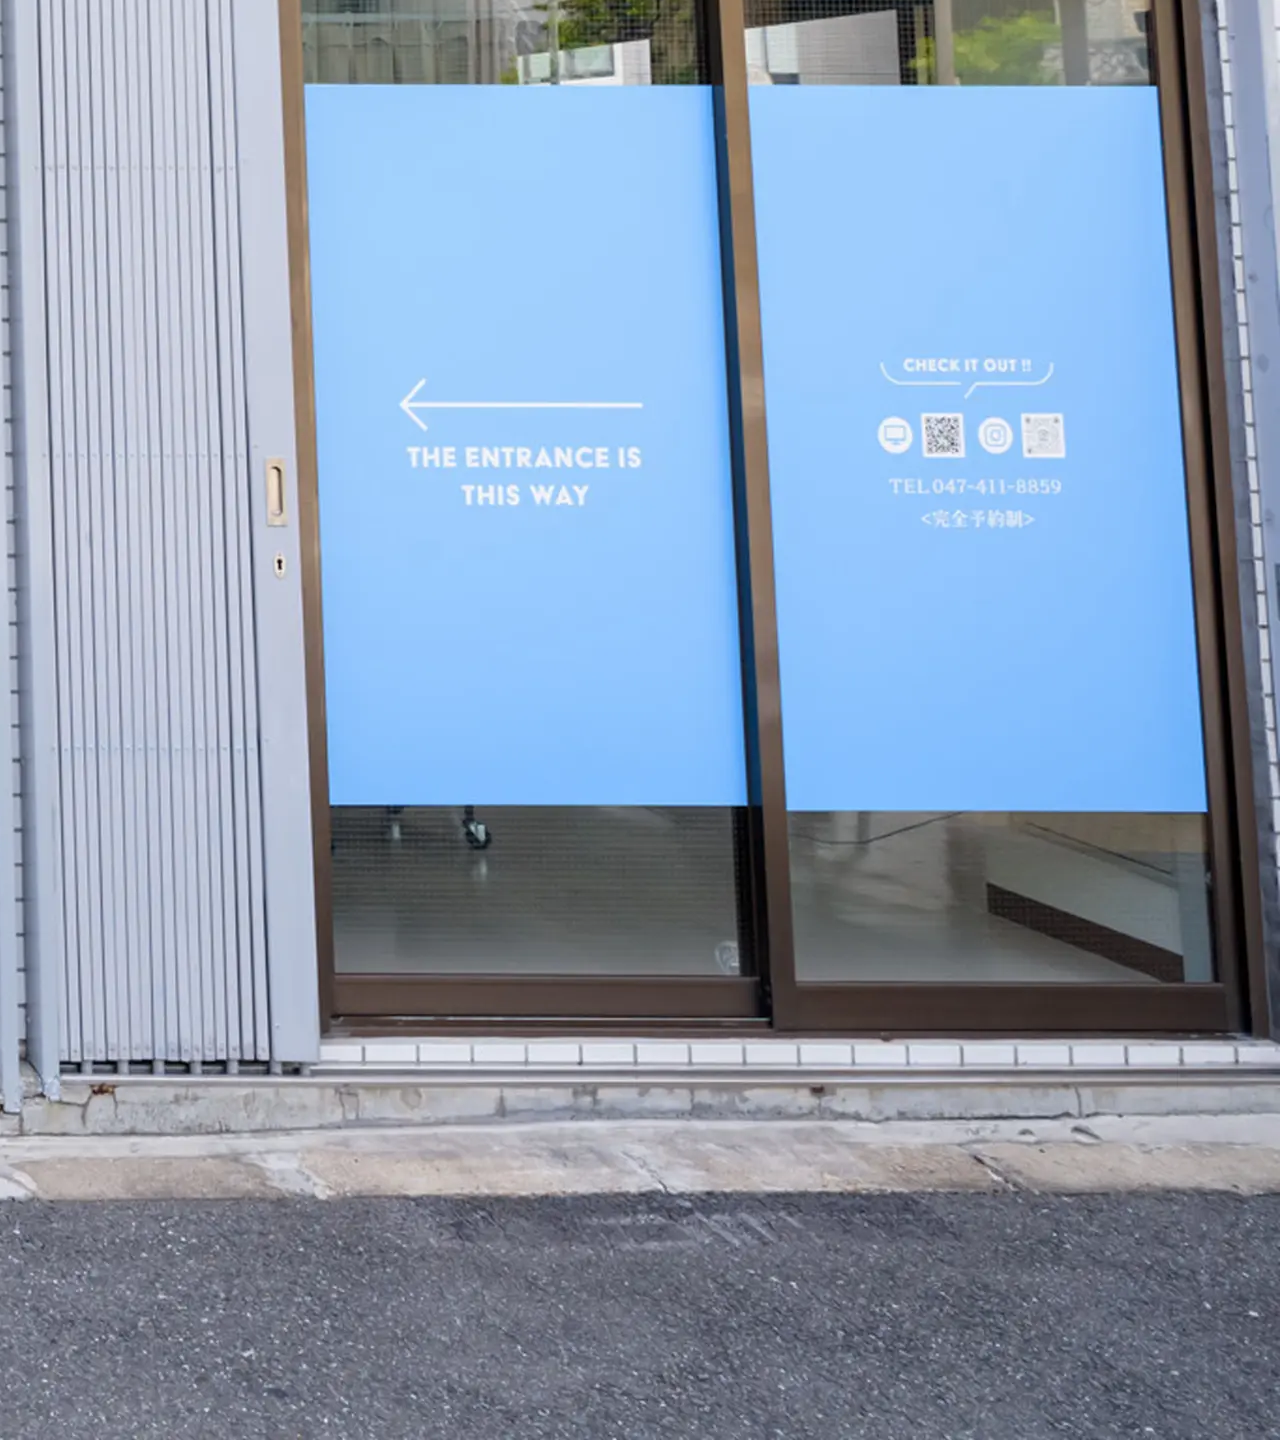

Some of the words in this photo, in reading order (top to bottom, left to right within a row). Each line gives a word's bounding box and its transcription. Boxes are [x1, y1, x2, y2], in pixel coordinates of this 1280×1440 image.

[902, 357, 961, 373] CHECK
[963, 357, 980, 373] IT
[982, 357, 1018, 373] OUT
[406, 445, 458, 469] THE
[464, 445, 611, 469] ENTRANCE
[617, 445, 643, 469] IS
[460, 483, 521, 507] THIS
[529, 483, 590, 507] WAY
